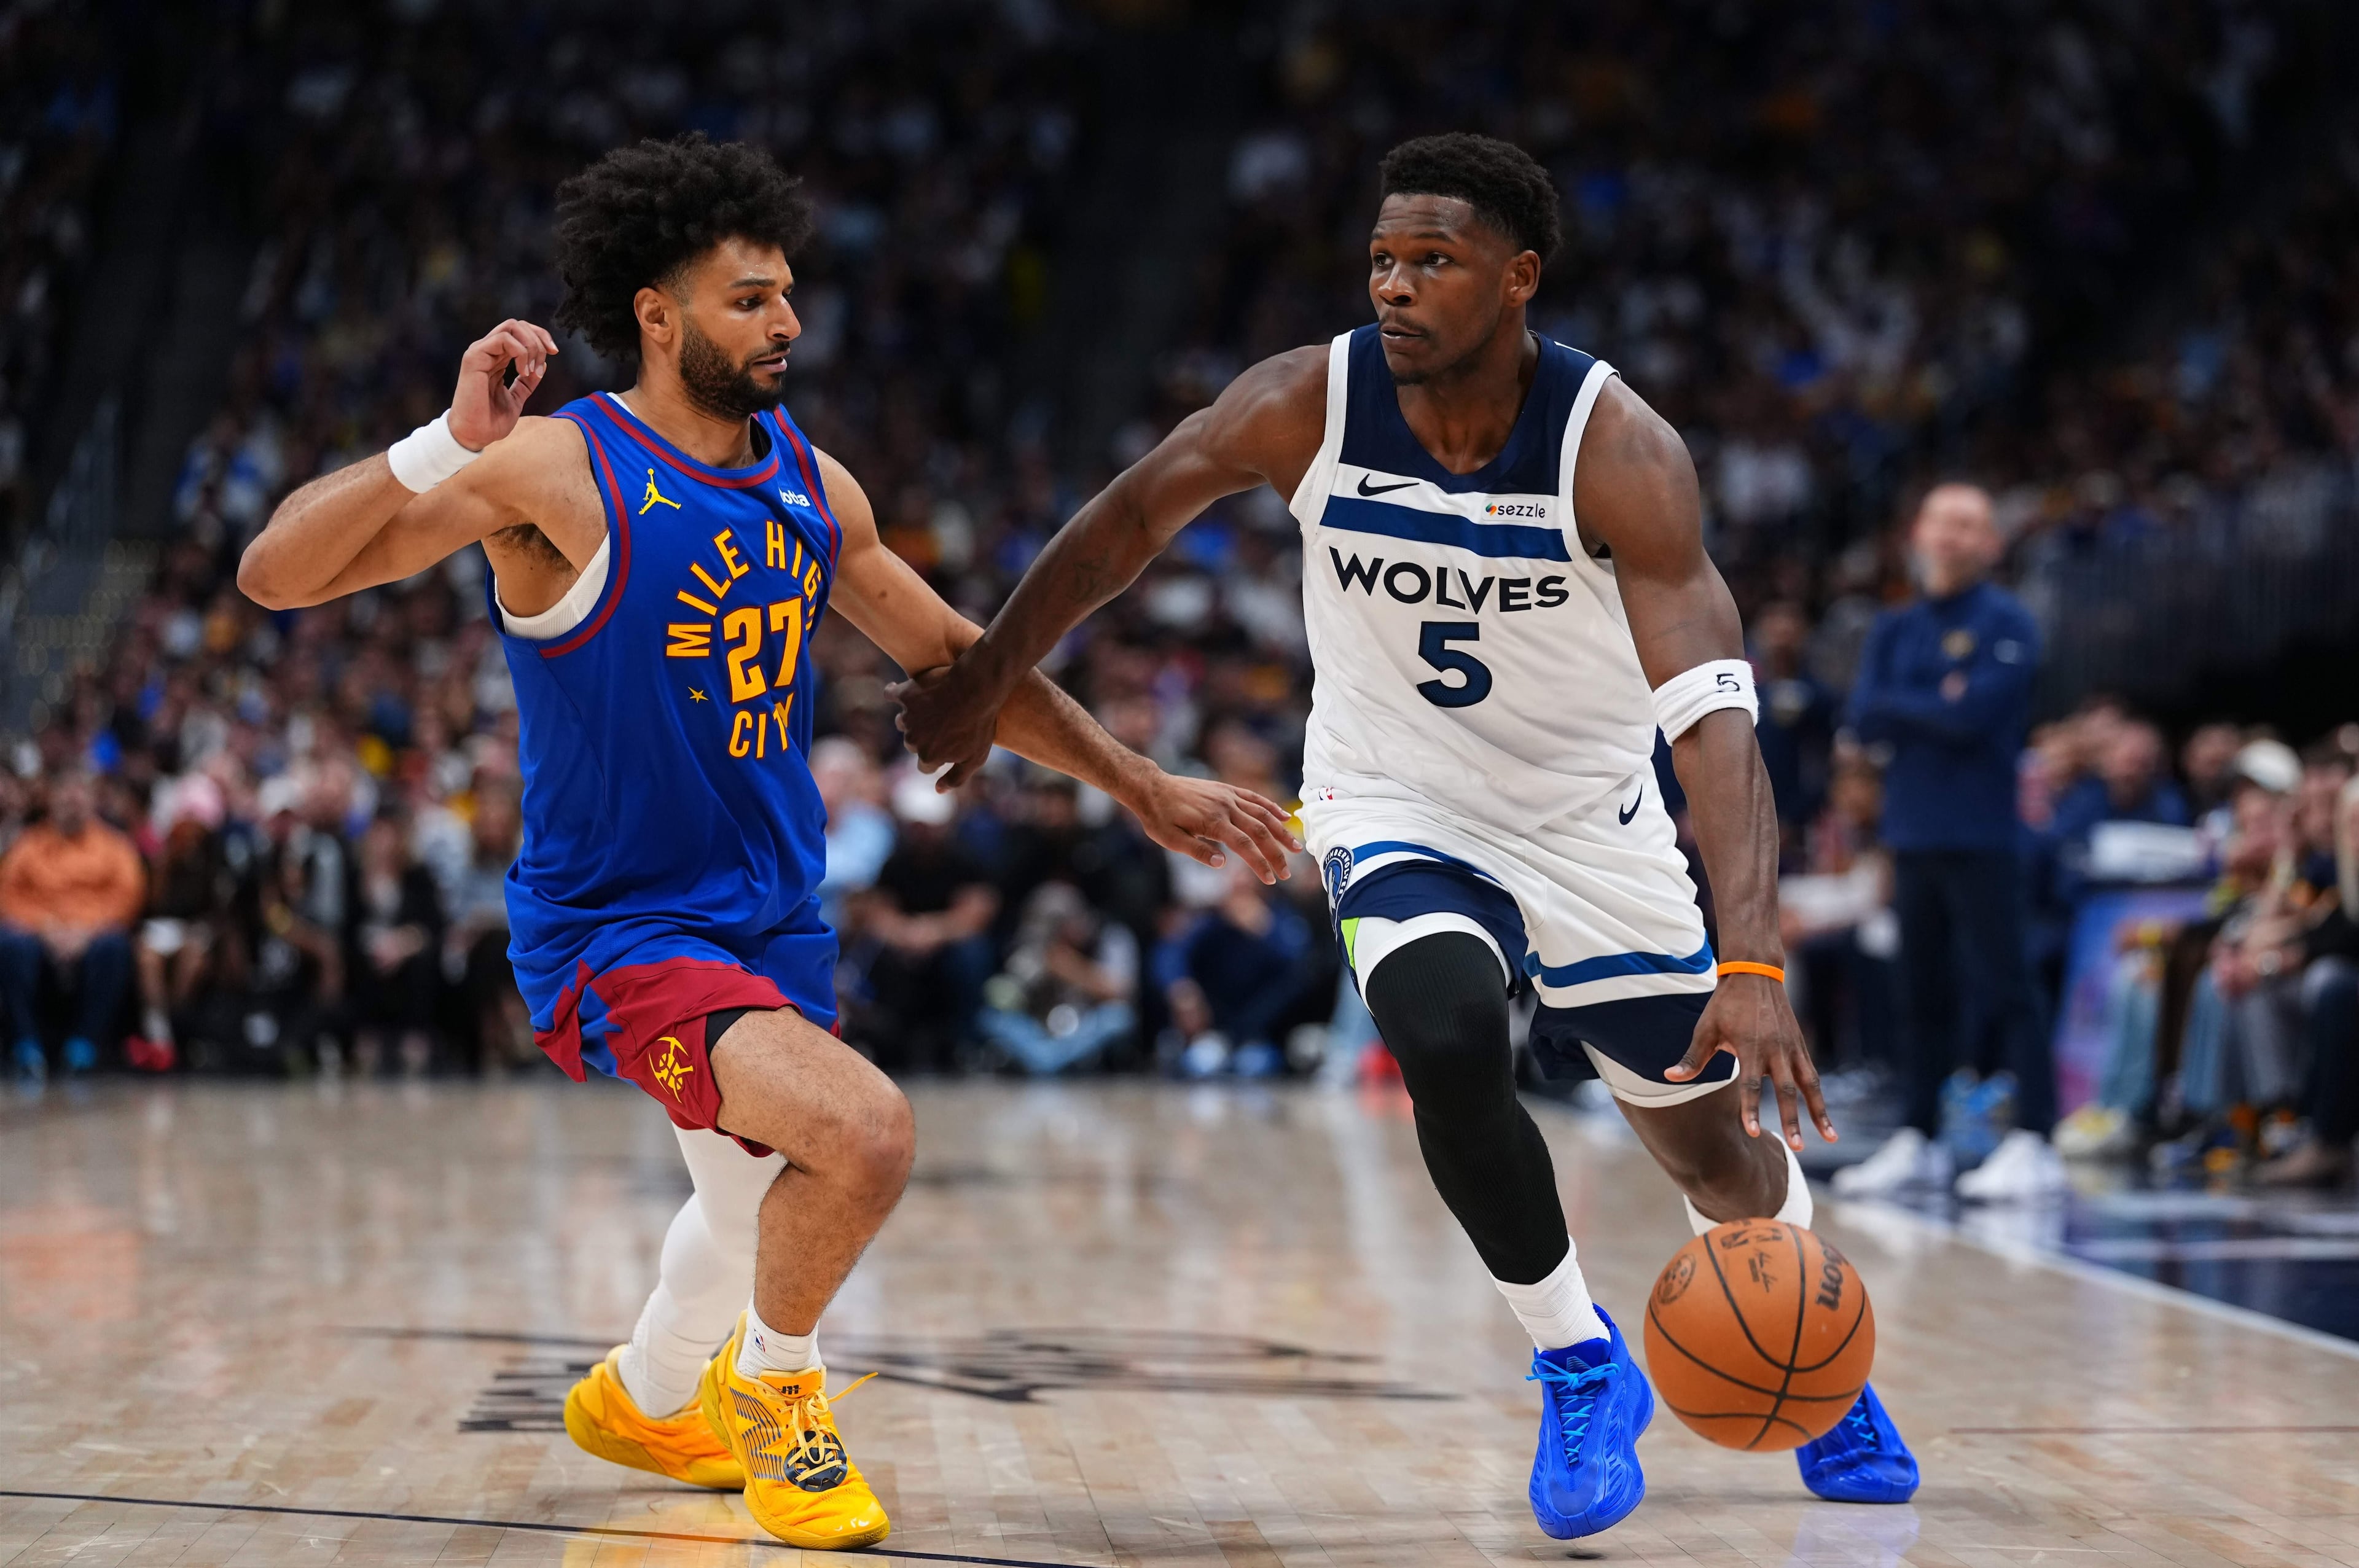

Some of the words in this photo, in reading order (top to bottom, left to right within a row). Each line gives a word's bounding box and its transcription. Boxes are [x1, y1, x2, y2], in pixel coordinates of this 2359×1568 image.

[1498, 503, 1546, 518] sezzle
[666, 526, 749, 658] MILE
[1329, 546, 1570, 615] WOLVES
[722, 595, 804, 704] 27
[1417, 621, 1493, 708] 5
[1716, 673, 1740, 693] 5
